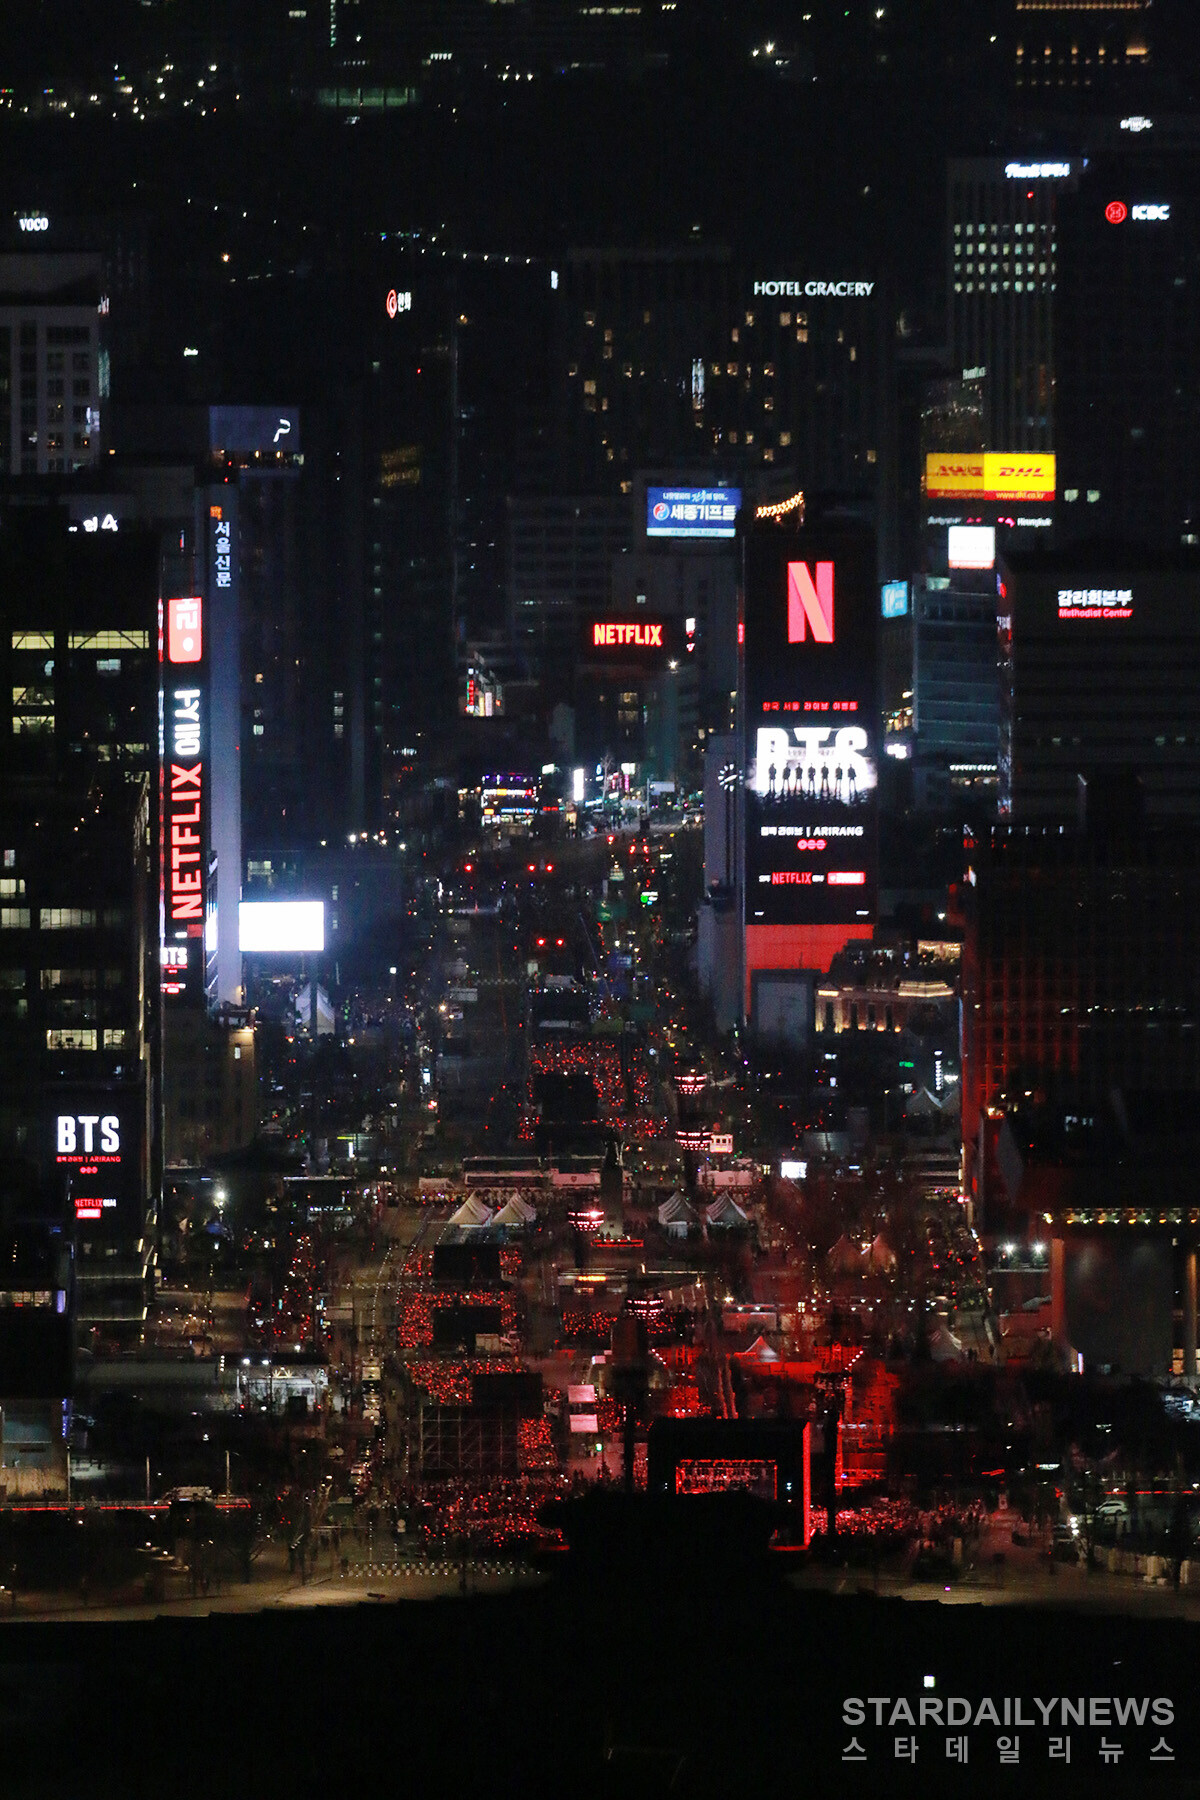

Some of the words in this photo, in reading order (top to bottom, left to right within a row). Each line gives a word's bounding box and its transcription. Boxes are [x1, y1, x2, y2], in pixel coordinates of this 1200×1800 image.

[1132, 204, 1169, 220] ICBC
[754, 281, 803, 297] HOTEL
[805, 281, 875, 297] GRACERY
[998, 467, 1045, 477] DHL
[670, 504, 736, 520] 세종기프트
[215, 521, 231, 587] 서울신문
[787, 561, 835, 643] N
[1057, 590, 1133, 607] 감리회본부
[1058, 607, 1101, 619] Methodist
[1102, 607, 1134, 619] Center
[593, 623, 663, 647] NETFLIX
[804, 701, 830, 711] 라이브
[757, 727, 869, 796] BTS
[813, 826, 864, 837] ARIRANG
[171, 763, 203, 920] NETFLIX
[772, 872, 812, 886] NETFLIX
[57, 1116, 119, 1153] BTS
